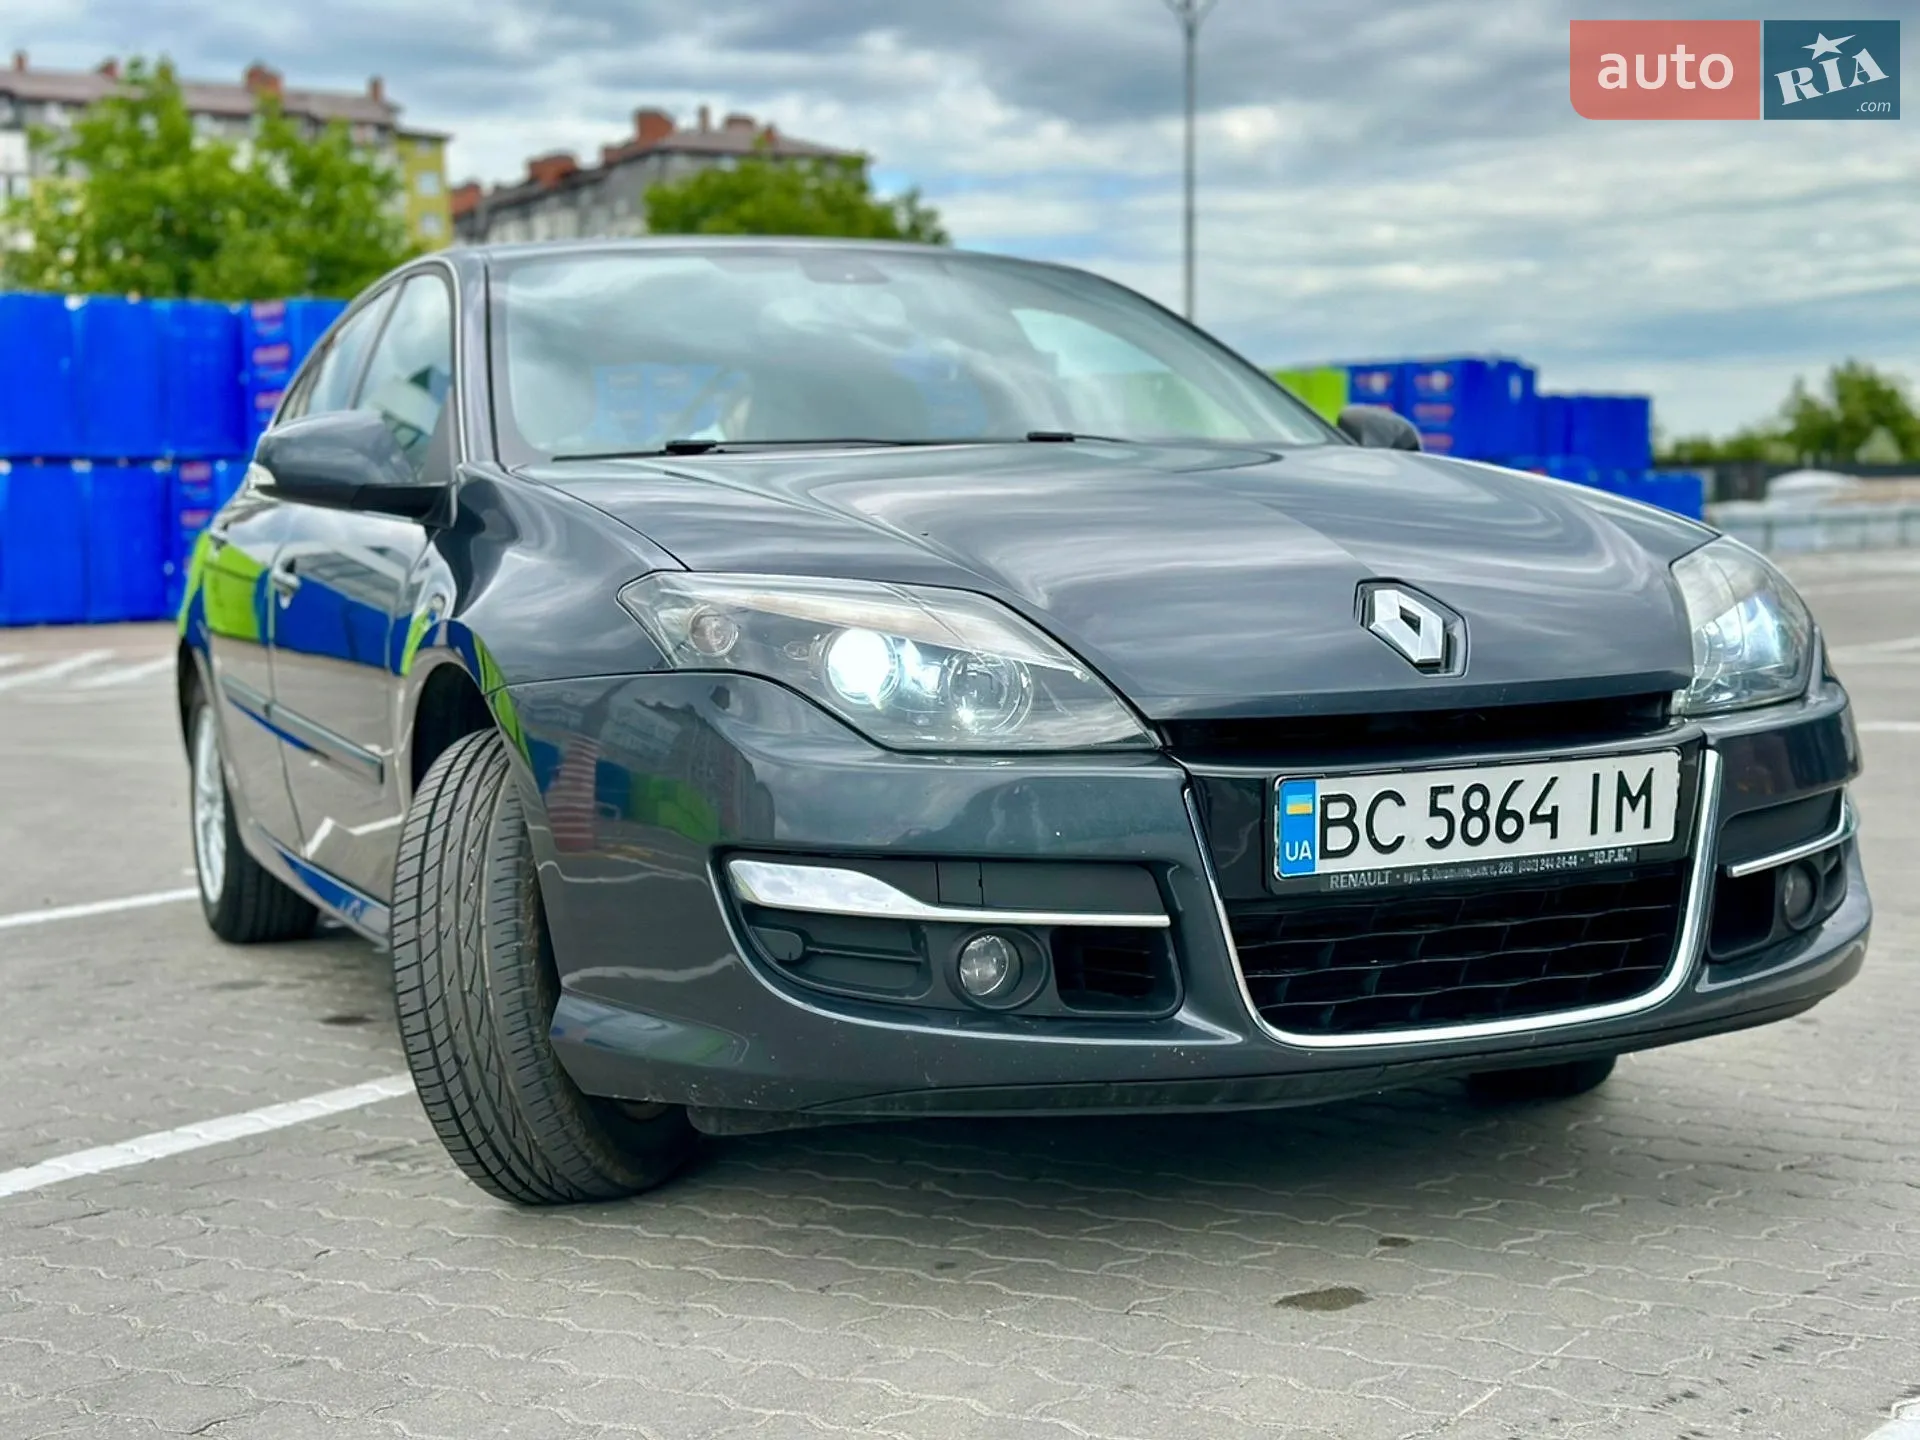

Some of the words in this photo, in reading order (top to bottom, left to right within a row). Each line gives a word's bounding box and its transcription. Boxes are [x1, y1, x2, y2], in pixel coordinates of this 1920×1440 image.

[1319, 787, 1406, 860] BC
[1425, 776, 1559, 850] 5864
[1590, 767, 1654, 836] IM
[1285, 840, 1313, 861] UA
[1329, 870, 1393, 889] RENAULT
